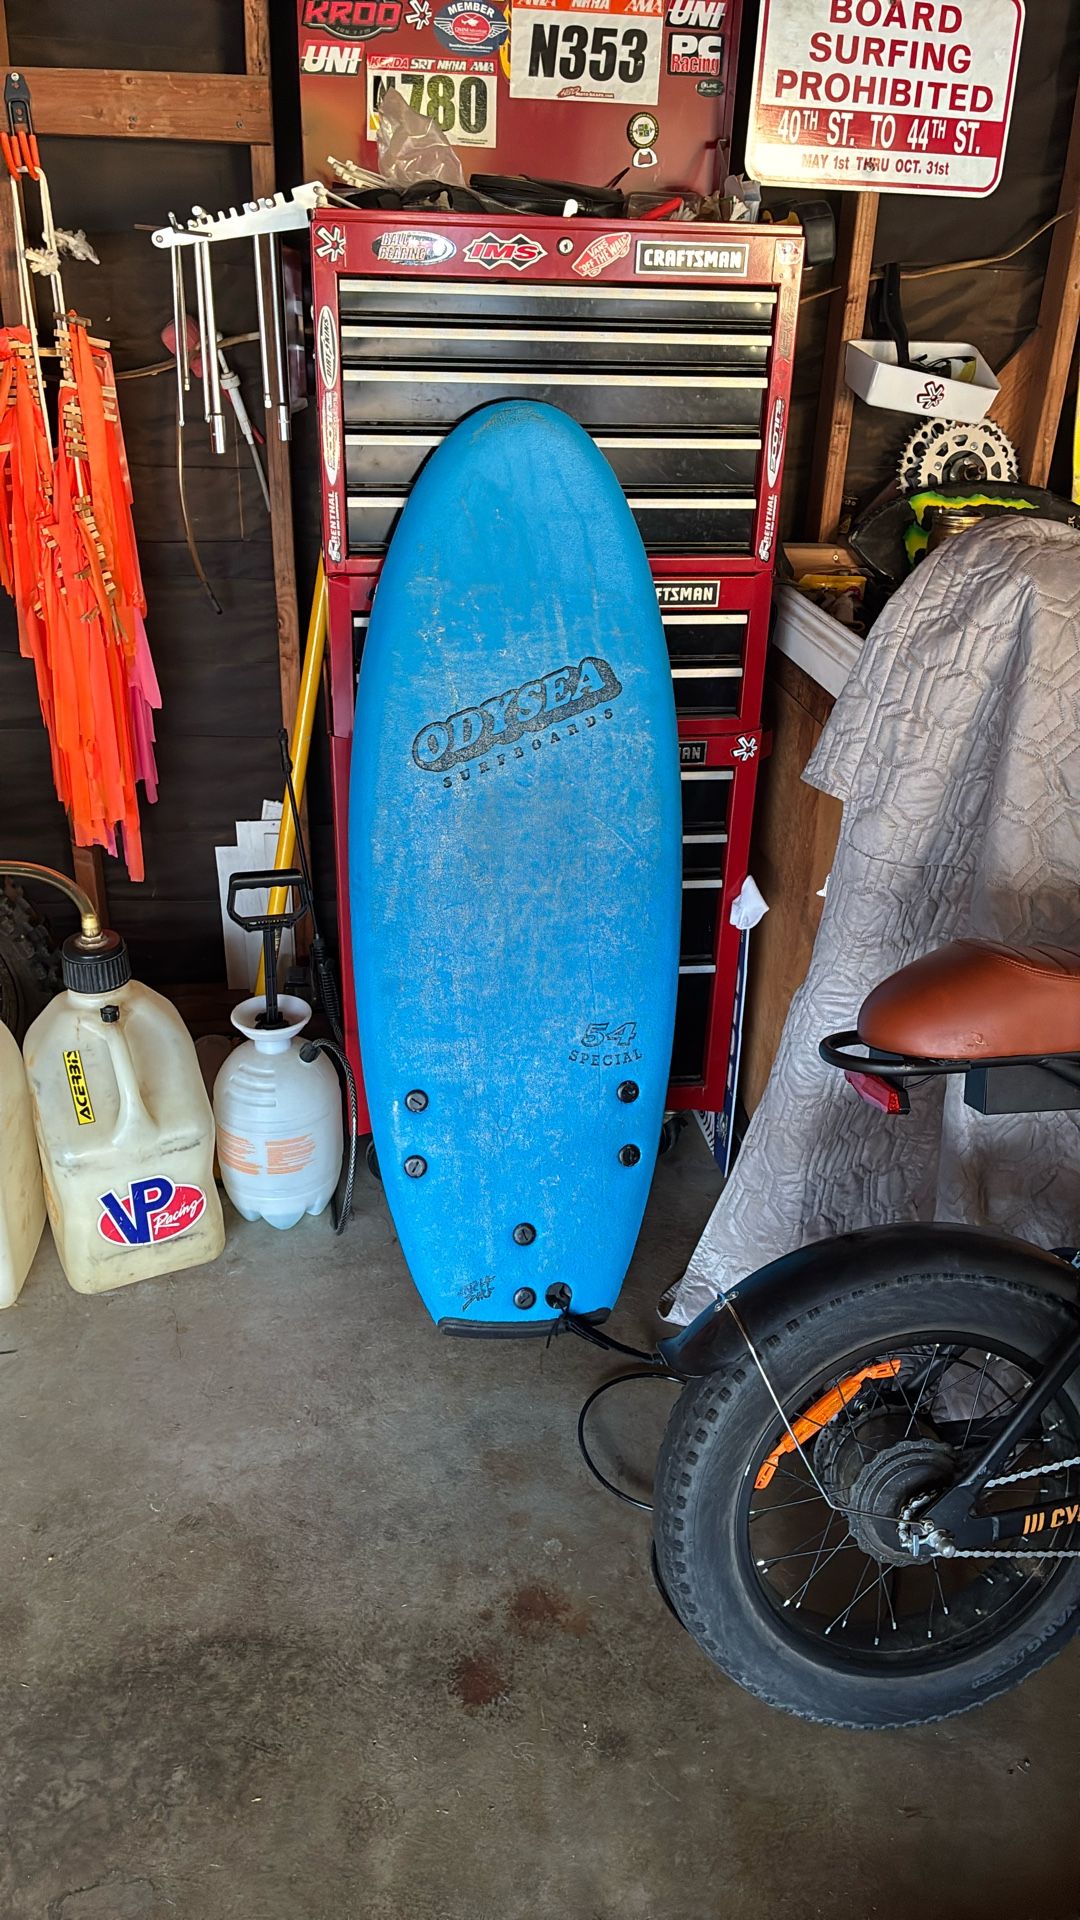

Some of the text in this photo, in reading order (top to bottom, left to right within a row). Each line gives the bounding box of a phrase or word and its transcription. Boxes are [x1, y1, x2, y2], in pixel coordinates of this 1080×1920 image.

[447, 2, 495, 19] MEMBER
[668, 0, 726, 28] UNI
[829, 0, 964, 34] BOARD
[301, 45, 363, 74] UNI
[528, 23, 648, 84] N353
[672, 35, 722, 58] PC
[809, 32, 972, 74] SURFING
[671, 53, 720, 75] Racing
[775, 69, 994, 114] PROHIBITED
[827, 111, 856, 147] ST.
[870, 114, 897, 149] TO
[953, 120, 981, 155] ST.
[802, 153, 950, 176] MAY 1st THRU OCT. 31st
[470, 243, 540, 261] IMS
[643, 248, 742, 269] CRAFTSMAN
[328, 491, 339, 548] RENTHAL
[763, 494, 775, 545] RENTHAL
[655, 587, 714, 602] FTSMAN
[412, 657, 616, 771] ODYSEA
[443, 708, 613, 788] SURFBOARDS
[581, 1022, 637, 1048] 54
[568, 1048, 642, 1067] SPECIAL
[100, 1177, 174, 1244] VP
[153, 1199, 202, 1235] Racing
[1050, 1503, 1080, 1529] CY
